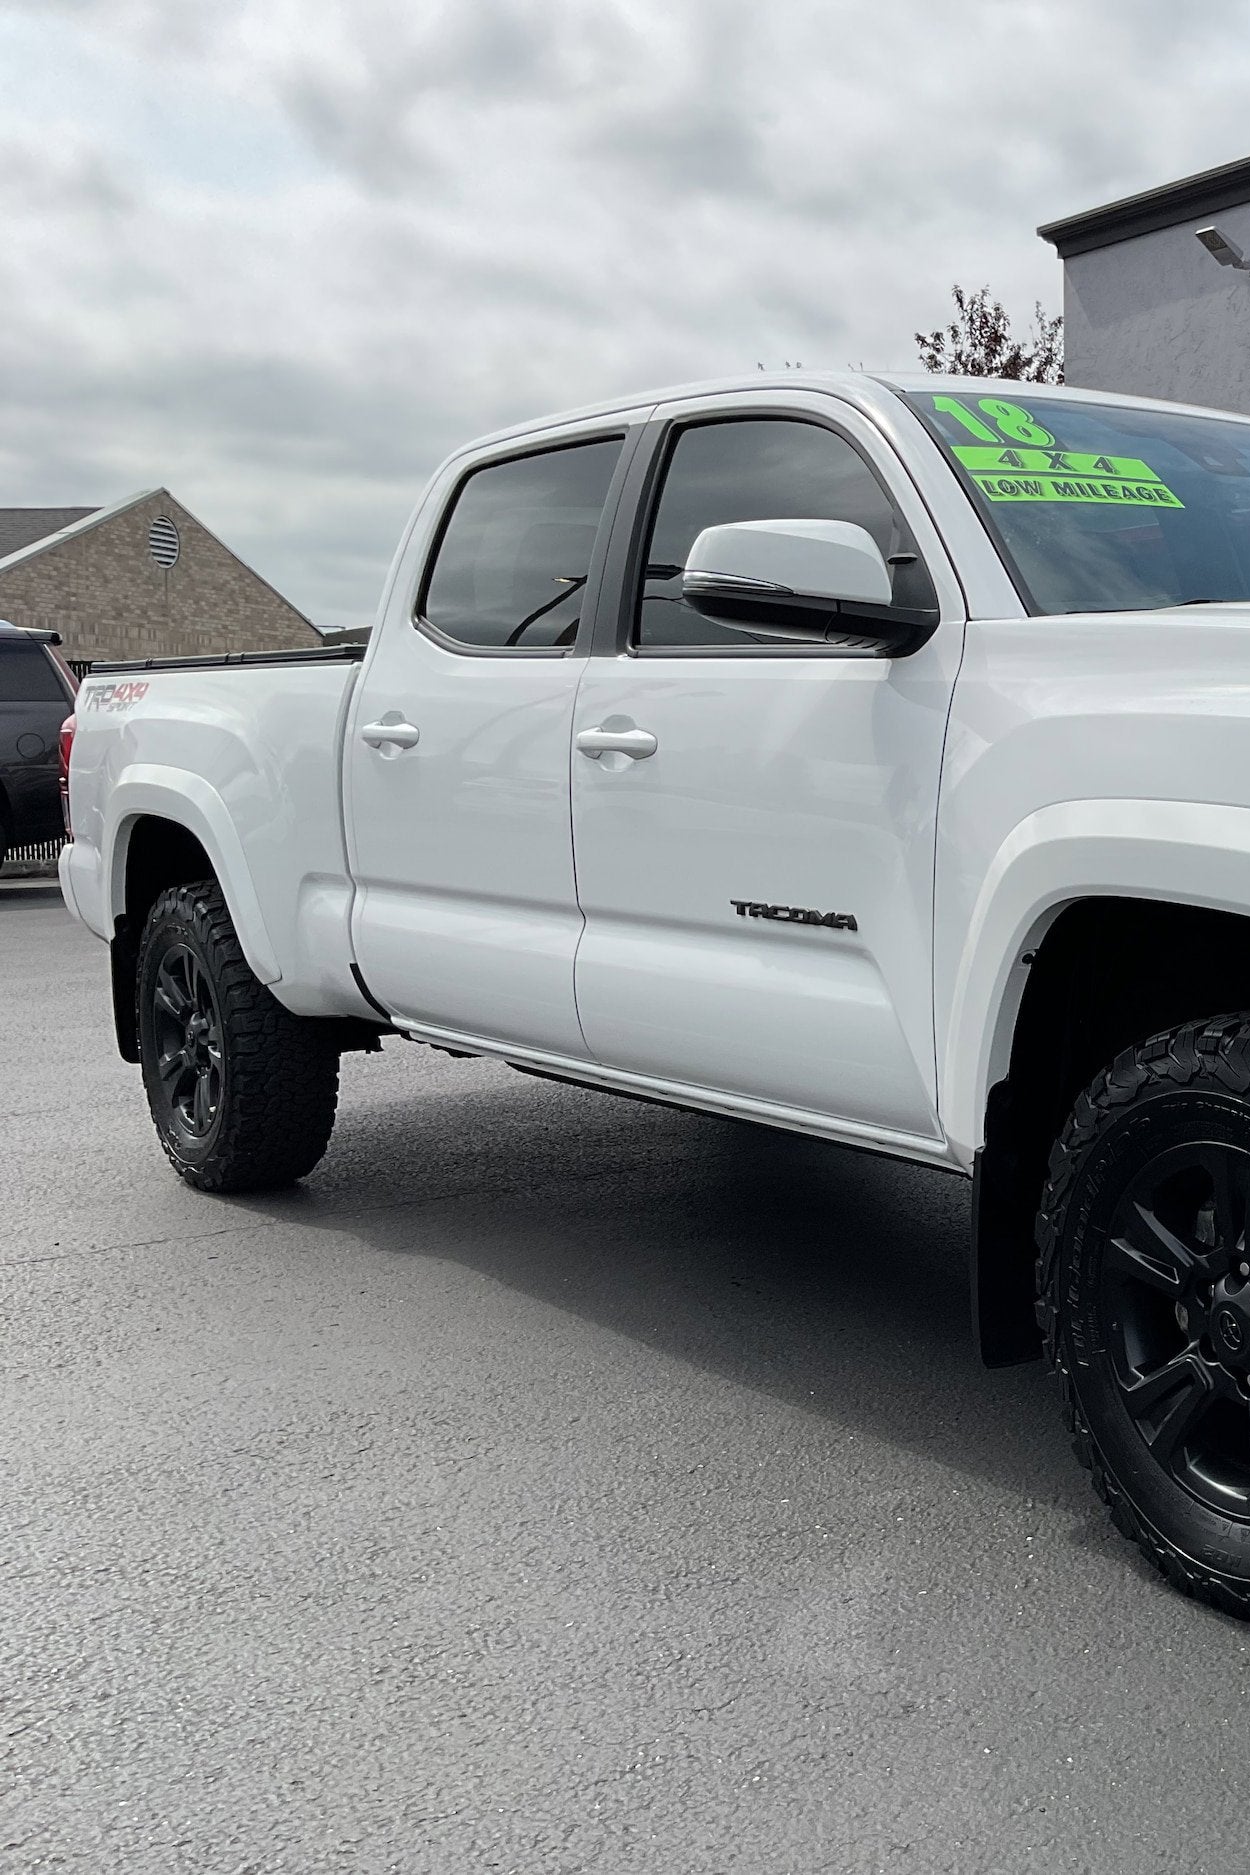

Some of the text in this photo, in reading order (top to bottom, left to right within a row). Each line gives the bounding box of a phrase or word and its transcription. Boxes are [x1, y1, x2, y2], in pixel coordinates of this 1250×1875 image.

[931, 396, 1056, 447] 18
[981, 478, 1173, 502] LOW MILEAGE
[729, 899, 858, 932] TACOMA
